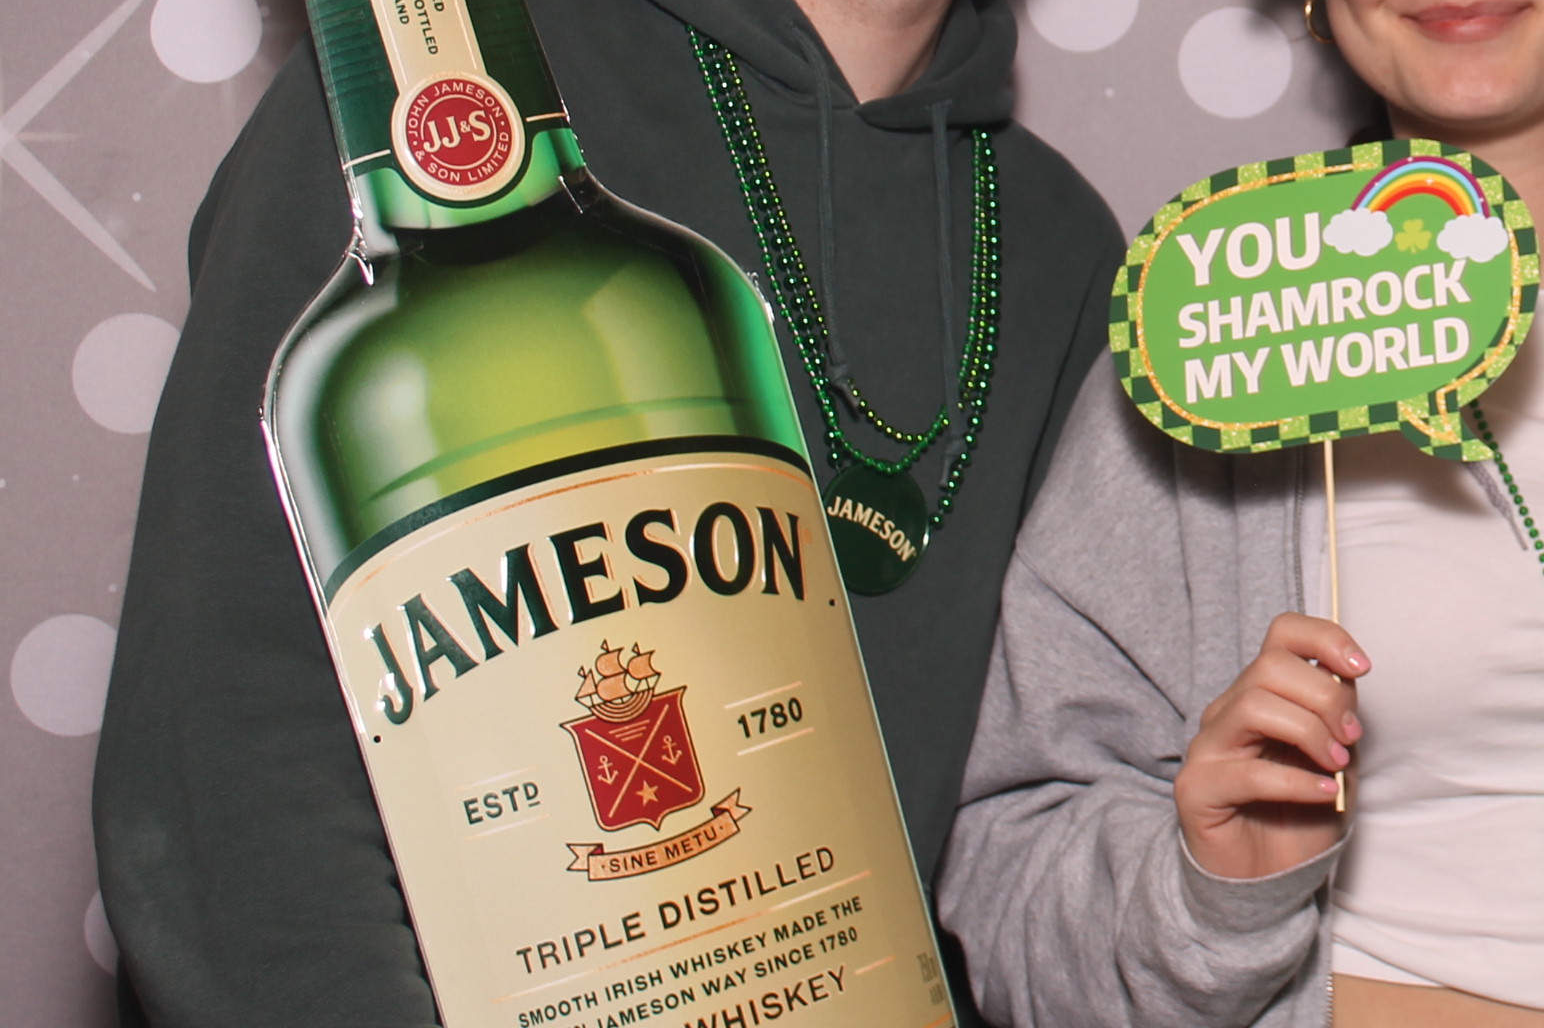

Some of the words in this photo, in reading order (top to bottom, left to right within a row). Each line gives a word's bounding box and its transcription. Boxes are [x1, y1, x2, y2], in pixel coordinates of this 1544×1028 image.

[408, 95, 429, 137] JOHN
[433, 82, 503, 117] JAMESON
[423, 110, 491, 153] JJ&S
[428, 162, 460, 182] SON
[467, 132, 509, 181] LIMITED
[1175, 212, 1321, 287] YOU
[1177, 258, 1471, 348] SHAMROCK
[1184, 346, 1270, 404] MY
[1281, 316, 1470, 387] WORLD
[827, 496, 915, 562] JAMESON
[367, 500, 807, 725] JAMESON
[737, 697, 804, 739] 1780
[609, 850, 657, 873] SINE
[665, 826, 718, 859] METU
[516, 912, 646, 974] TRIPLE
[659, 846, 835, 930] DISTILLED
[518, 991, 599, 1028] SMOOTH
[604, 970, 663, 1002] IRISH
[669, 932, 767, 979] WHISKEY
[773, 910, 828, 942] MADE
[831, 896, 863, 919] THE
[597, 986, 696, 1028] JAMESON
[701, 968, 746, 996] WAY
[754, 943, 815, 978] SINCE
[819, 926, 858, 953] 1780
